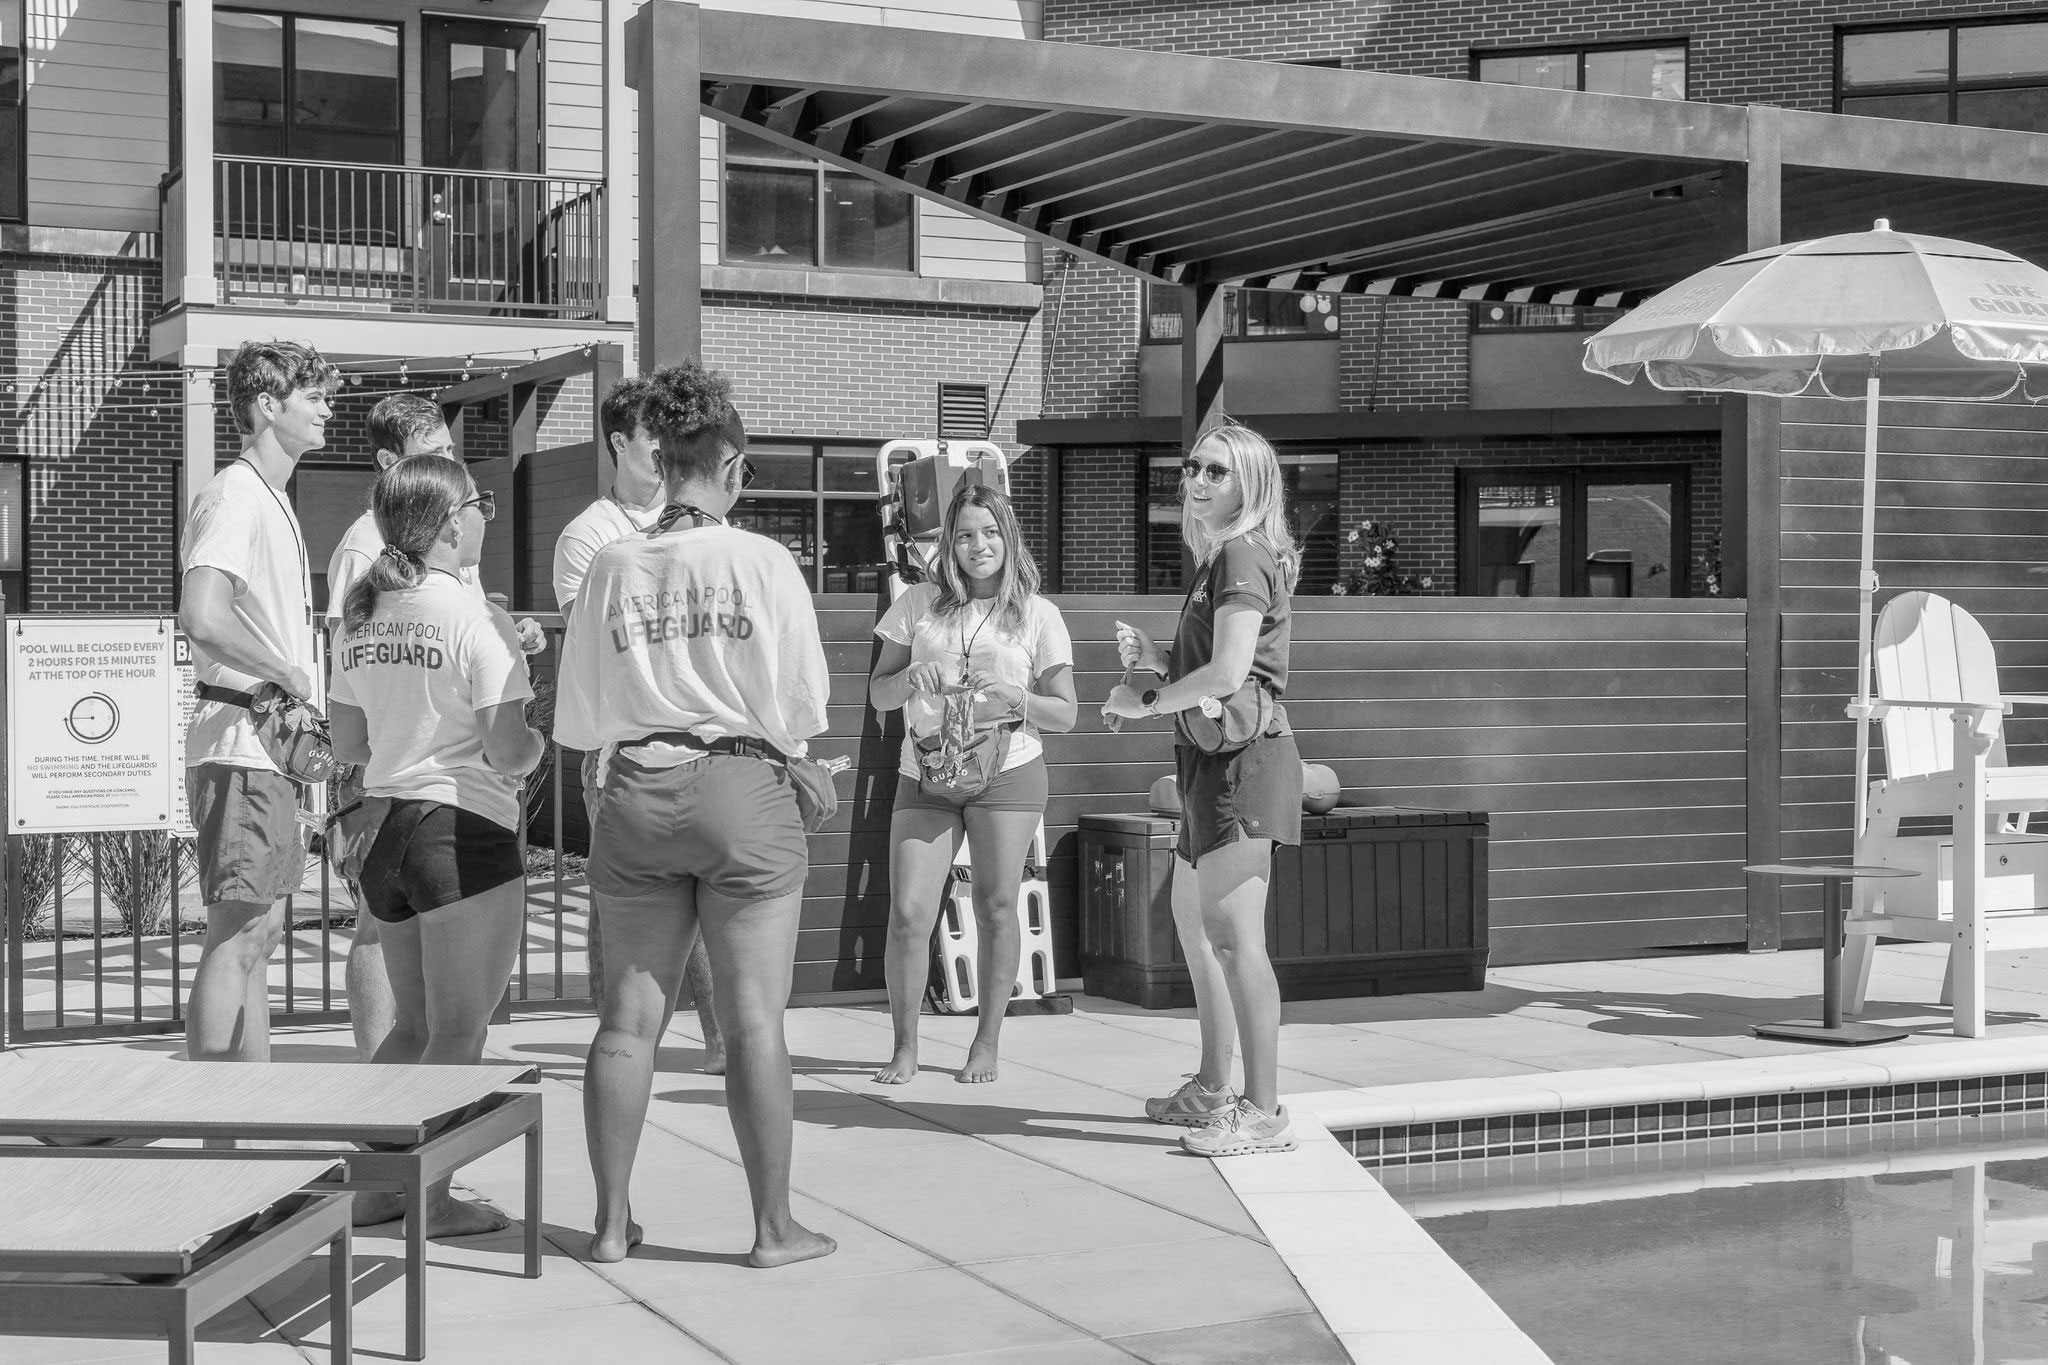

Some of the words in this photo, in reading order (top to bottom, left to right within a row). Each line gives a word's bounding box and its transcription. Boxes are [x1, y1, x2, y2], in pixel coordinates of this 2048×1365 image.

[1983, 283, 2042, 299] LIFE
[608, 587, 698, 622] AMERICAN
[703, 586, 753, 609] POOL
[342, 622, 404, 646] ERICAN
[406, 622, 444, 642] POOL
[19, 644, 49, 654] POOL
[50, 644, 75, 653] WILL
[77, 643, 89, 653] BE
[91, 642, 132, 652] CLOSED
[134, 642, 165, 651] EVERY
[28, 658, 35, 667] 2
[36, 657, 73, 667] HOURS
[75, 657, 96, 666] FOR
[97, 656, 109, 665] 15
[111, 655, 156, 665] MINUTES
[341, 643, 443, 672] LIFEGUARD
[29, 671, 42, 680] AT
[43, 671, 64, 680] THE
[65, 670, 87, 679] TOP
[88, 670, 102, 679] OF
[103, 669, 124, 678] THE
[126, 669, 156, 678] HOUR
[309, 750, 333, 767] GUARD
